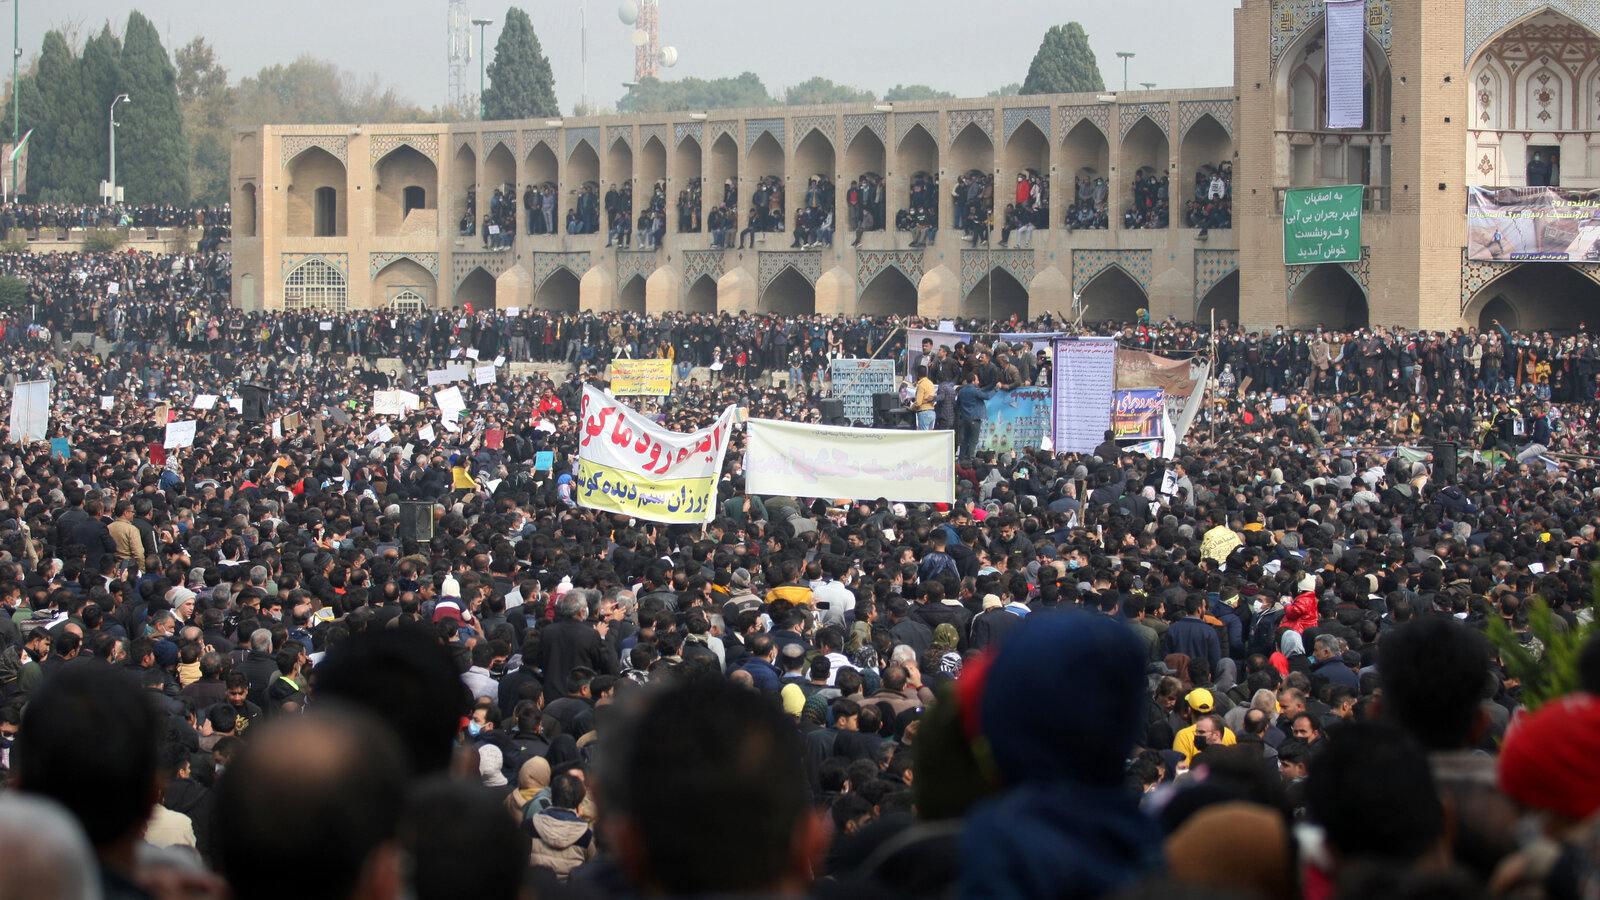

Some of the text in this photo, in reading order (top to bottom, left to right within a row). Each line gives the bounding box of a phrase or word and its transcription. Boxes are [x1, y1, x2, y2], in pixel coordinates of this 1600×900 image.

[1304, 191, 1343, 205] به اصفهان
[1285, 207, 1358, 224] شهر بحران بی آبی
[1294, 225, 1350, 240] و فرونشست
[1297, 243, 1346, 259] خوش آمدید
[611, 412, 633, 448] ما
[634, 432, 672, 475] رود
[602, 480, 637, 504] دیده
